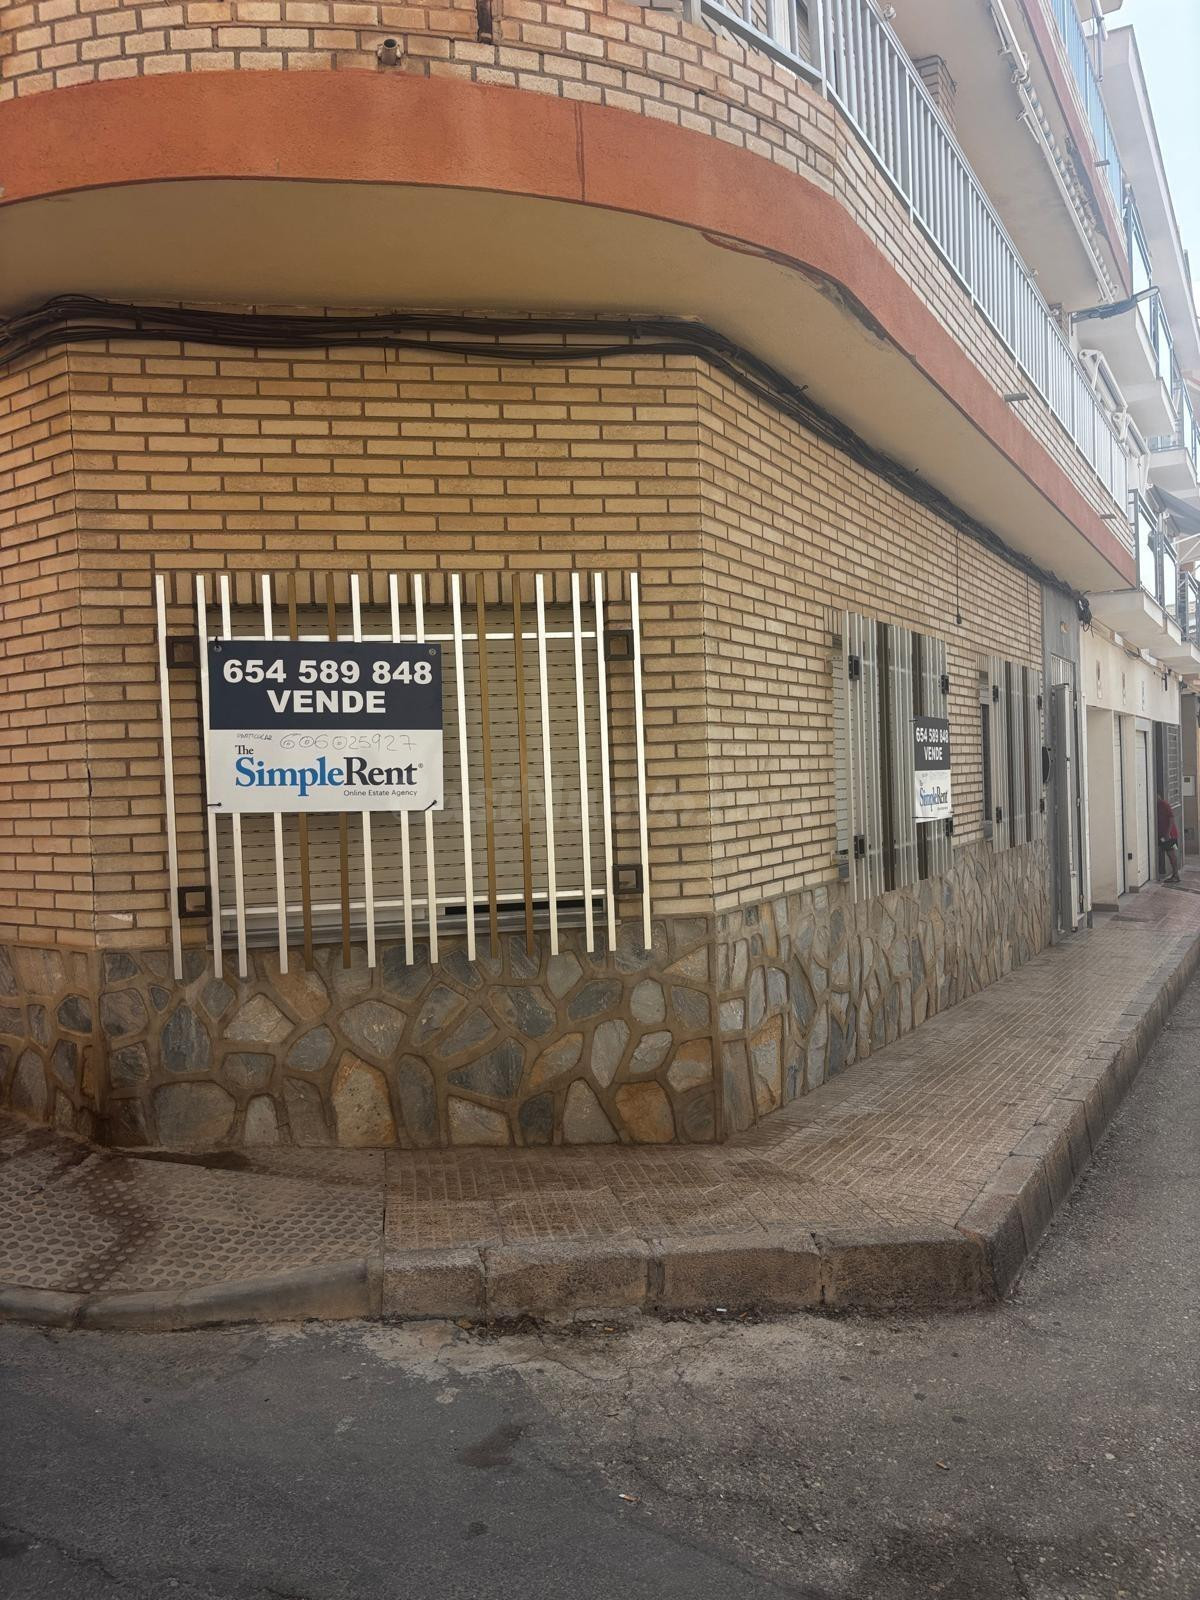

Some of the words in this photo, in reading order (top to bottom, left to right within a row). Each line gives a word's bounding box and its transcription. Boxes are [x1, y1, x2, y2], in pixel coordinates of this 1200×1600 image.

[223, 659, 286, 684] 654
[298, 660, 360, 684] 589
[372, 660, 432, 685] 848
[267, 690, 386, 713] VENDE
[916, 727, 928, 743] 654
[235, 745, 254, 755] The
[924, 746, 943, 761] VENDE
[343, 789, 367, 797] Online
[368, 789, 390, 797] Estate
[391, 789, 418, 798] Agency
